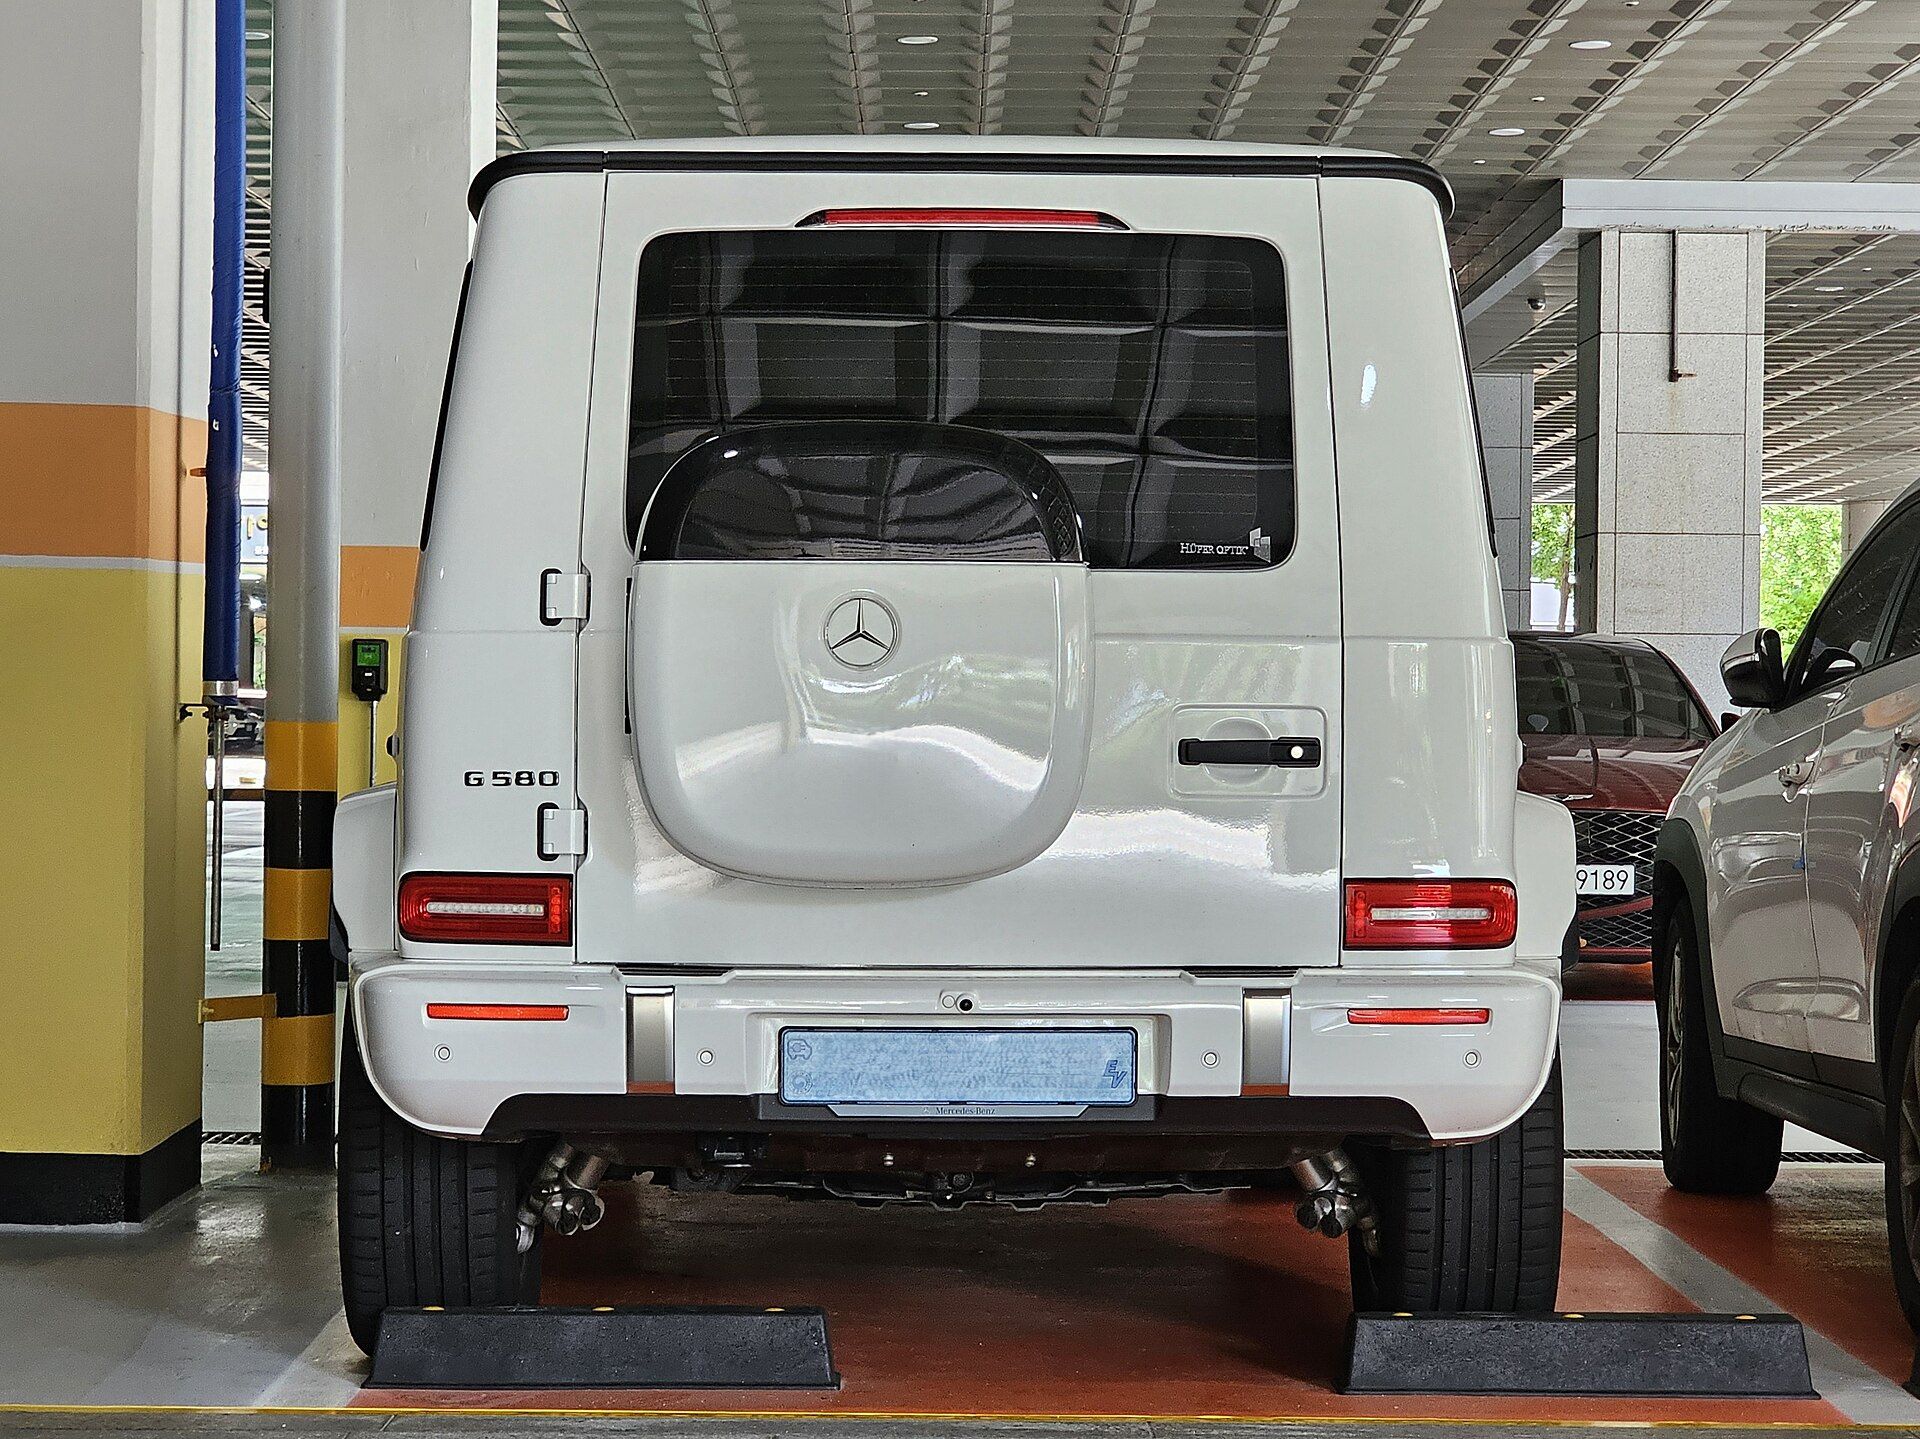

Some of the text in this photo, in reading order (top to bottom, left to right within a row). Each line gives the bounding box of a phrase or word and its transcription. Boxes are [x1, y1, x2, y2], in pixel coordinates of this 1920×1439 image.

[1216, 545, 1249, 556] OPTIK
[464, 771, 560, 787] G 580
[1576, 869, 1629, 890] 9189
[1103, 1059, 1128, 1089] EV
